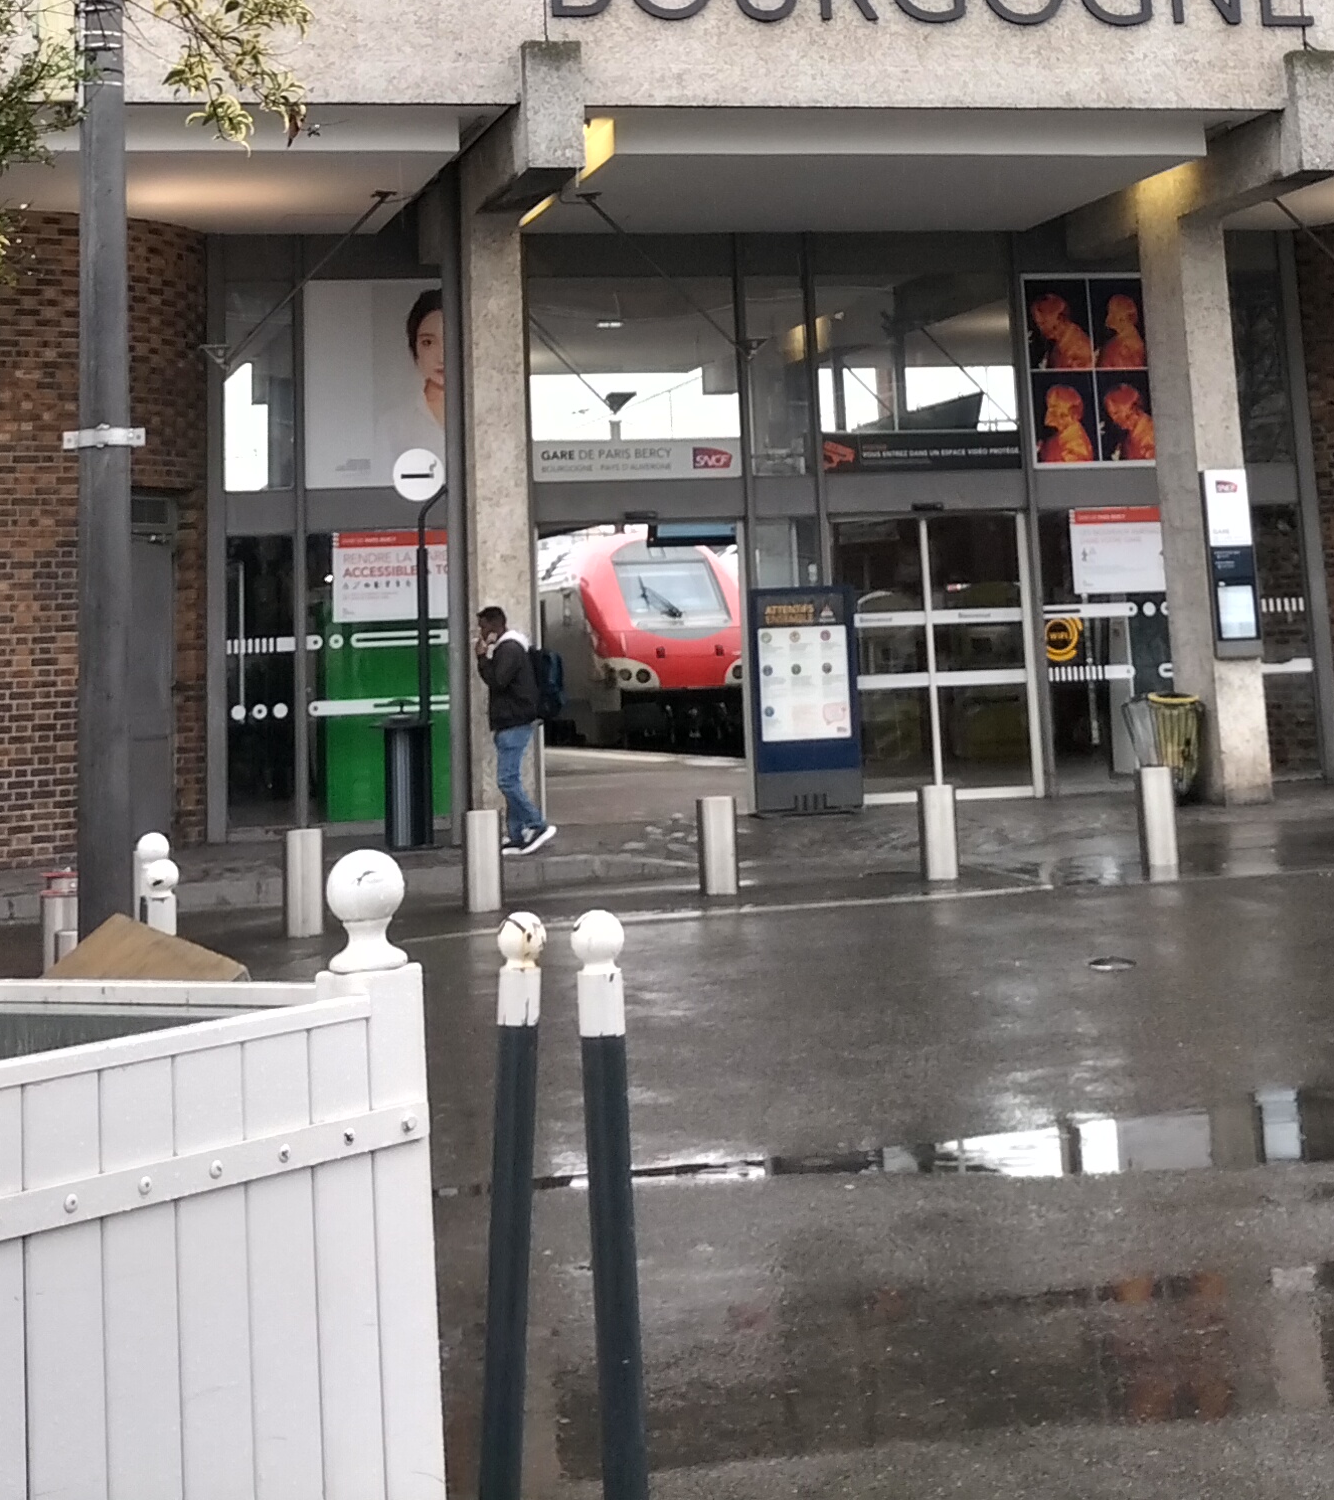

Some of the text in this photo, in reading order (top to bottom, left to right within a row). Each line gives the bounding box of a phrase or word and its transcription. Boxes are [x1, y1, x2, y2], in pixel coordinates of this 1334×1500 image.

[540, 447, 673, 461] GARE DE PARIS BERCY
[695, 454, 730, 467] SNCF
[342, 552, 393, 565] RENDRE
[396, 550, 413, 564] LA
[342, 565, 417, 578] ACCESSIBLE
